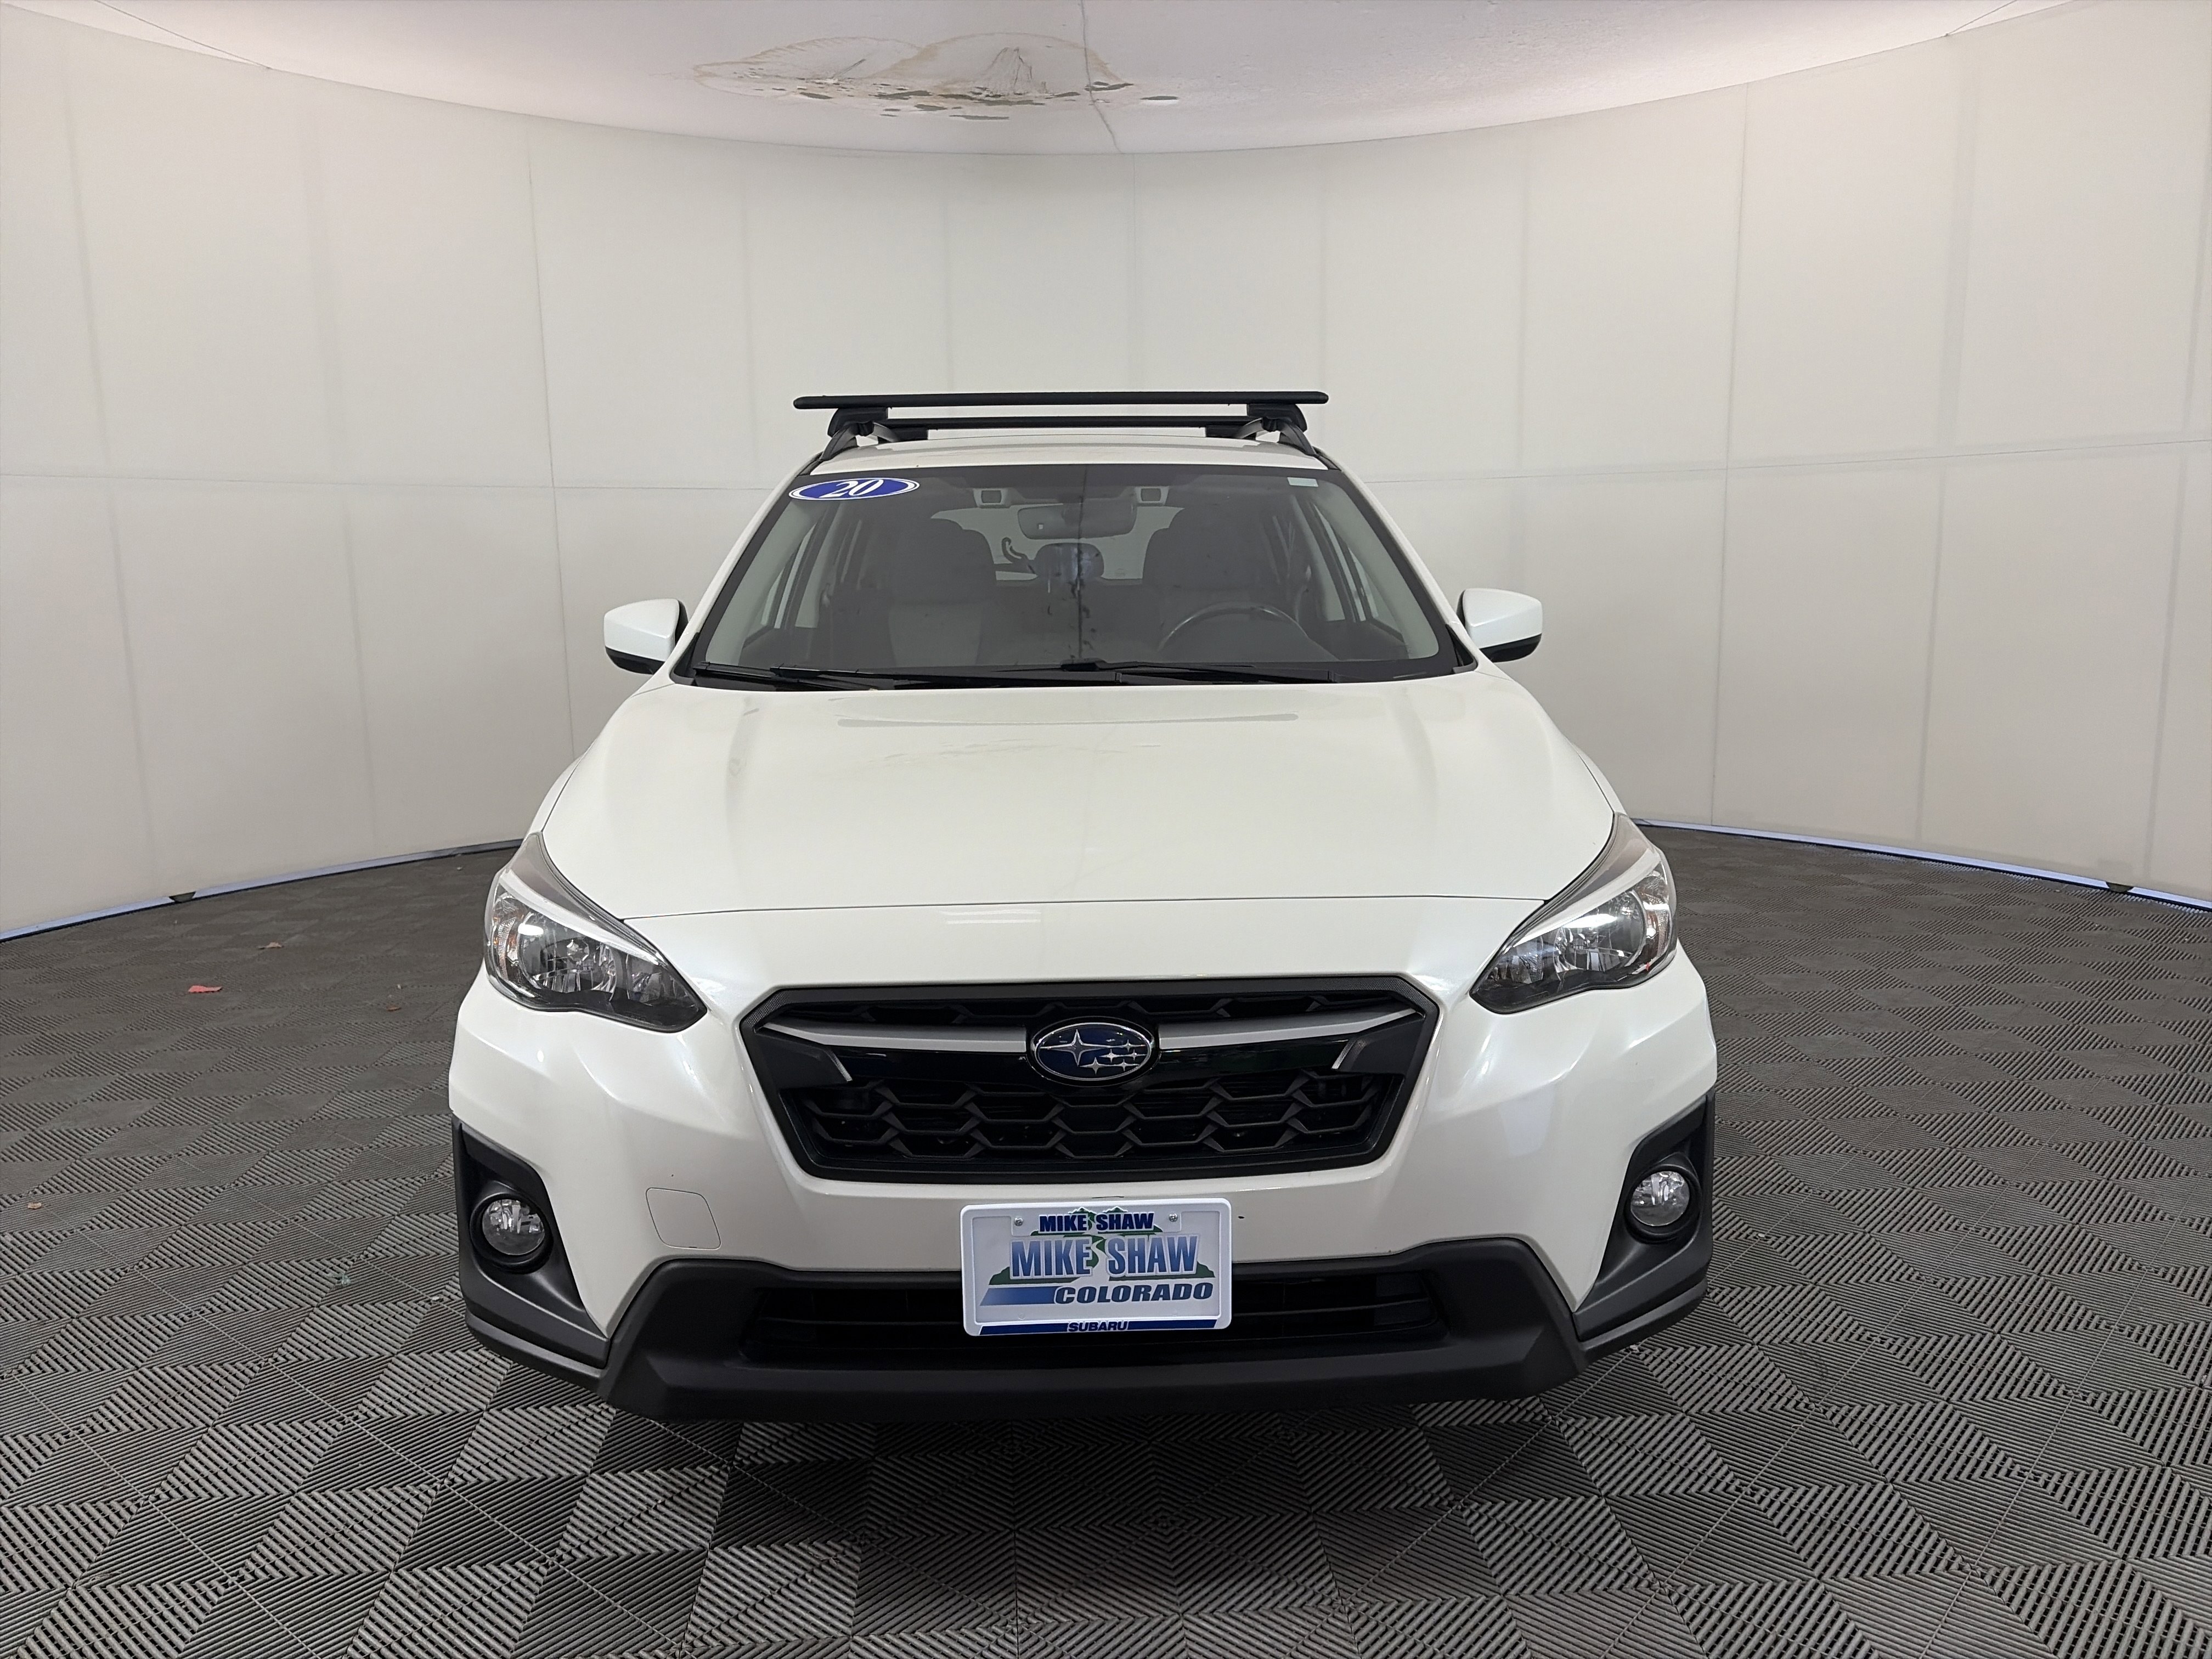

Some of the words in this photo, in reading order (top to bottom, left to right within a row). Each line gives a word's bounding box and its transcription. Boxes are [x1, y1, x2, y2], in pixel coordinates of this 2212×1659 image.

[819, 479, 884, 498] 20
[1040, 1214, 1087, 1232] MIKE
[1096, 1212, 1154, 1231] SHAW
[1012, 1238, 1091, 1277] MIKE
[1107, 1235, 1198, 1274] SHAW
[1054, 1282, 1213, 1304] COLORADO
[1068, 1321, 1128, 1333] SUBARU
